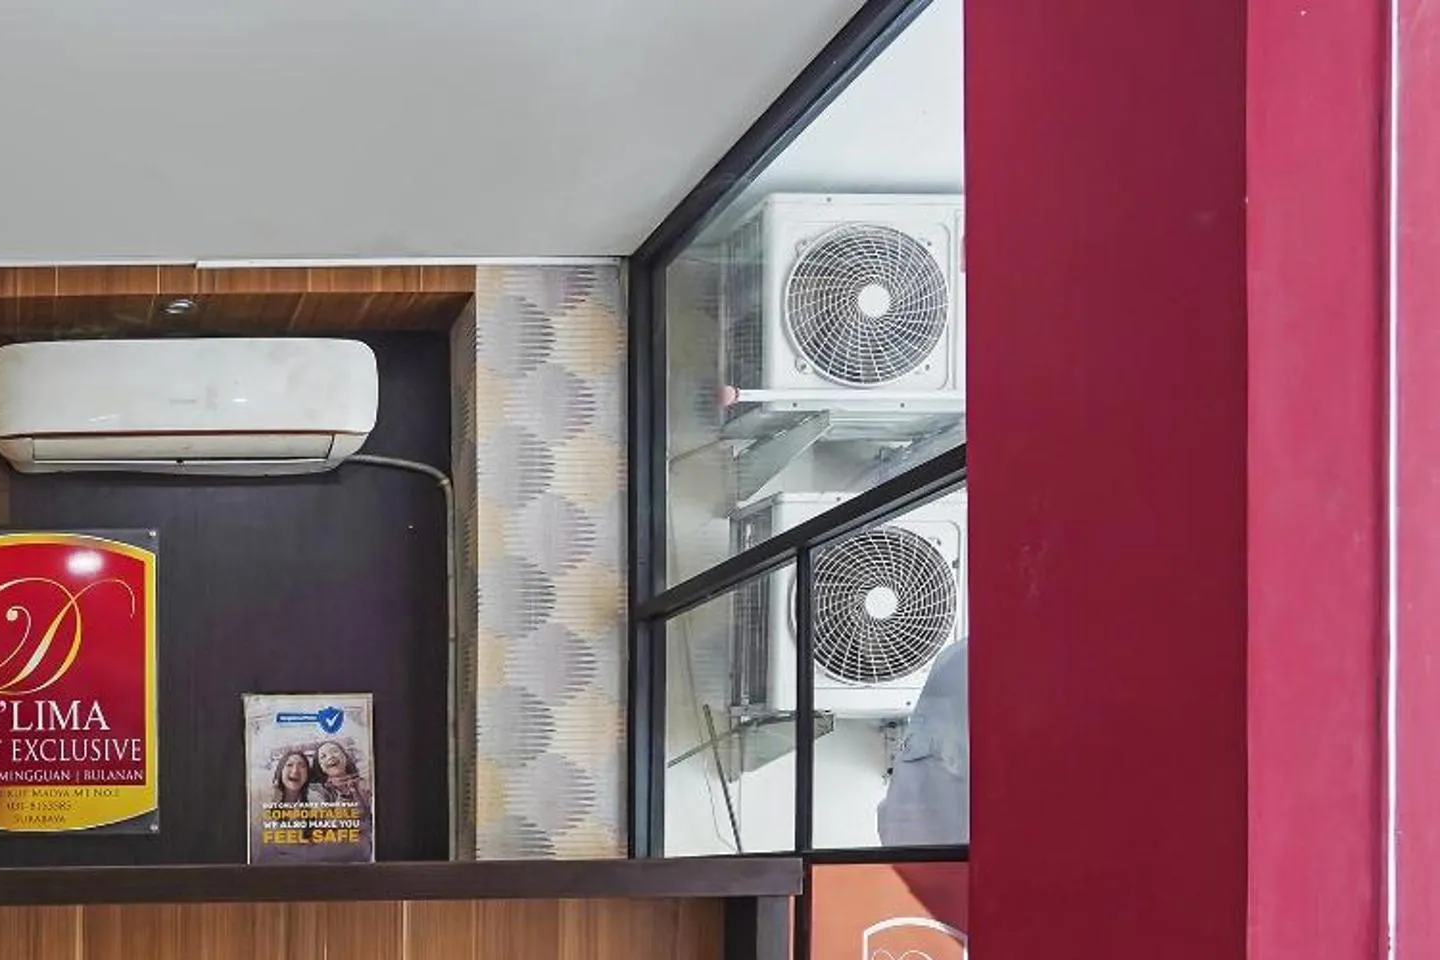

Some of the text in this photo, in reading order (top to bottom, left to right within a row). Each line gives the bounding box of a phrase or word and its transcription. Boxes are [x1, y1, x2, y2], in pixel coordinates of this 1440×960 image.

[12, 738, 142, 762] EXCLUSIVE
[83, 769, 144, 781] BULANAN
[263, 809, 360, 819] COMFORTABLE
[339, 819, 360, 828] YOU
[263, 829, 360, 844] FEEL SAFE
